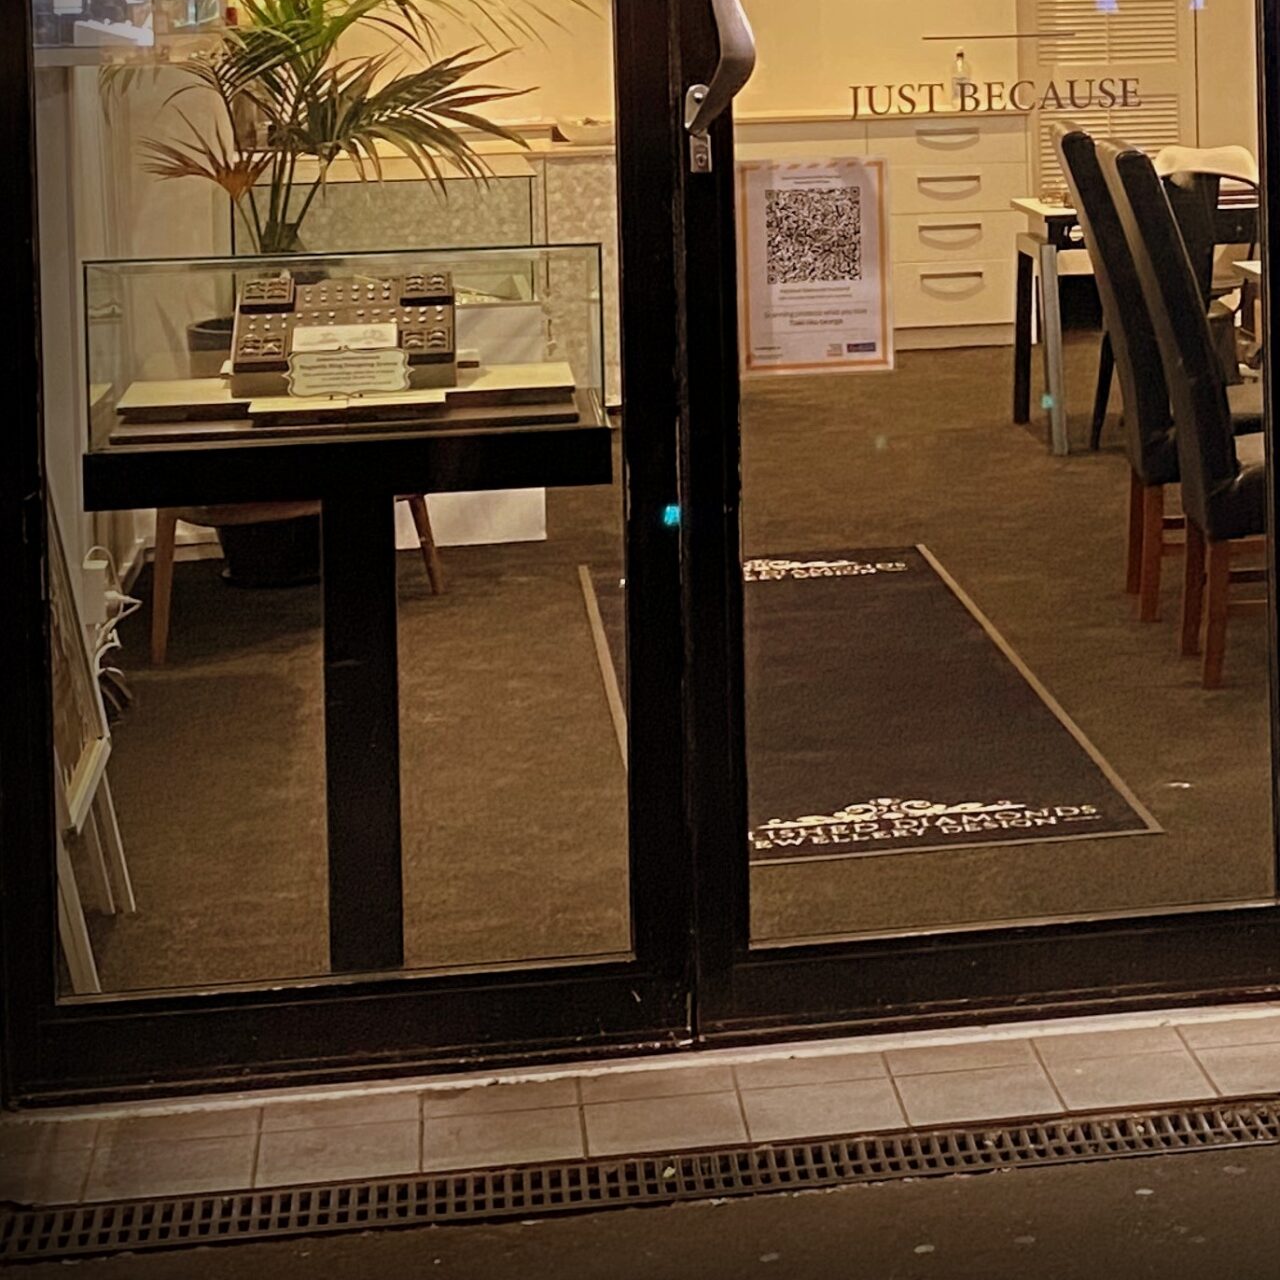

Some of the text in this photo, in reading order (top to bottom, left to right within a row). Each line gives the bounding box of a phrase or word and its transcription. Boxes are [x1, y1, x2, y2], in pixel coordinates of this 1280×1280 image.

[848, 77, 1142, 120] JUST BECAUSE
[755, 826, 926, 849] EWELLERY
